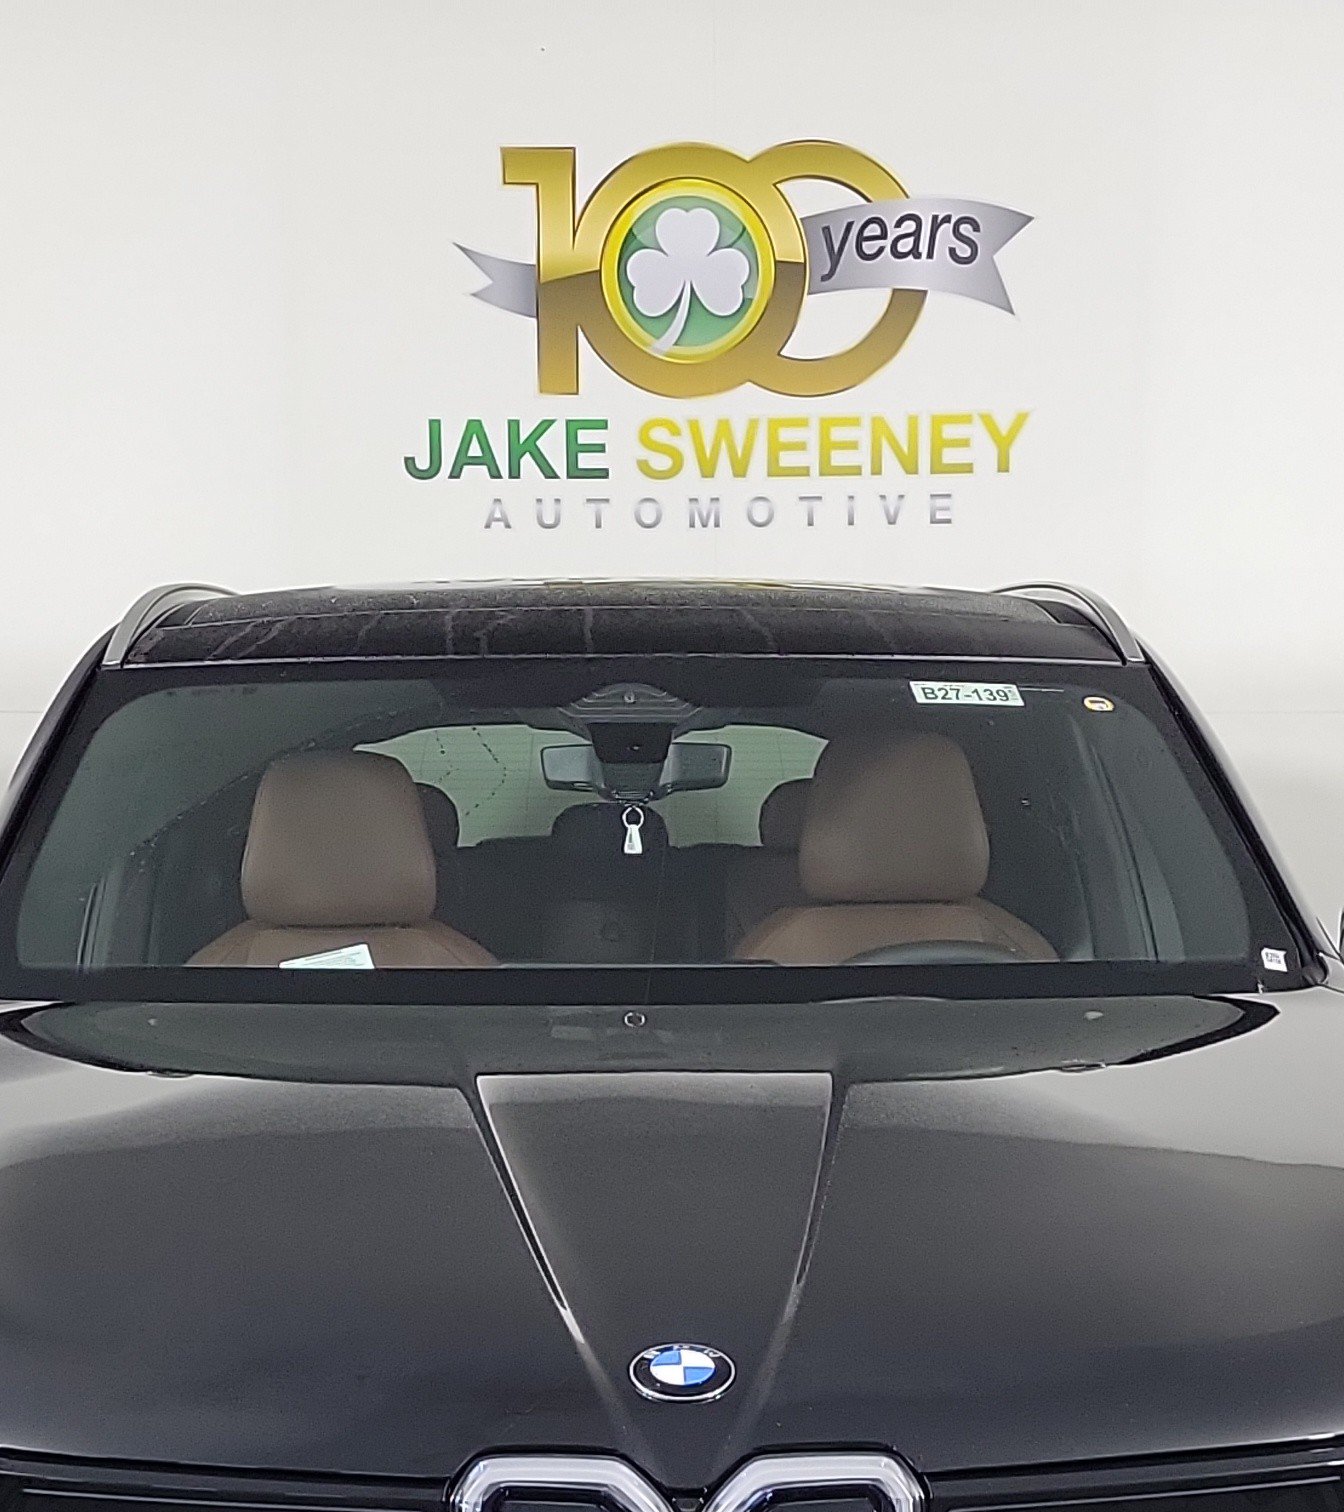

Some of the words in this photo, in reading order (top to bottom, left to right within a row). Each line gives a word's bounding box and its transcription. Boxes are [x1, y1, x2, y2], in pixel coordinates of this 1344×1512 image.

[500, 140, 928, 398] 100
[820, 209, 983, 282] years
[403, 418, 609, 481] JAKE
[635, 412, 1031, 481] SWEENEY
[483, 493, 954, 530] AUTOMOTIVE
[920, 686, 1010, 702] B27-139
